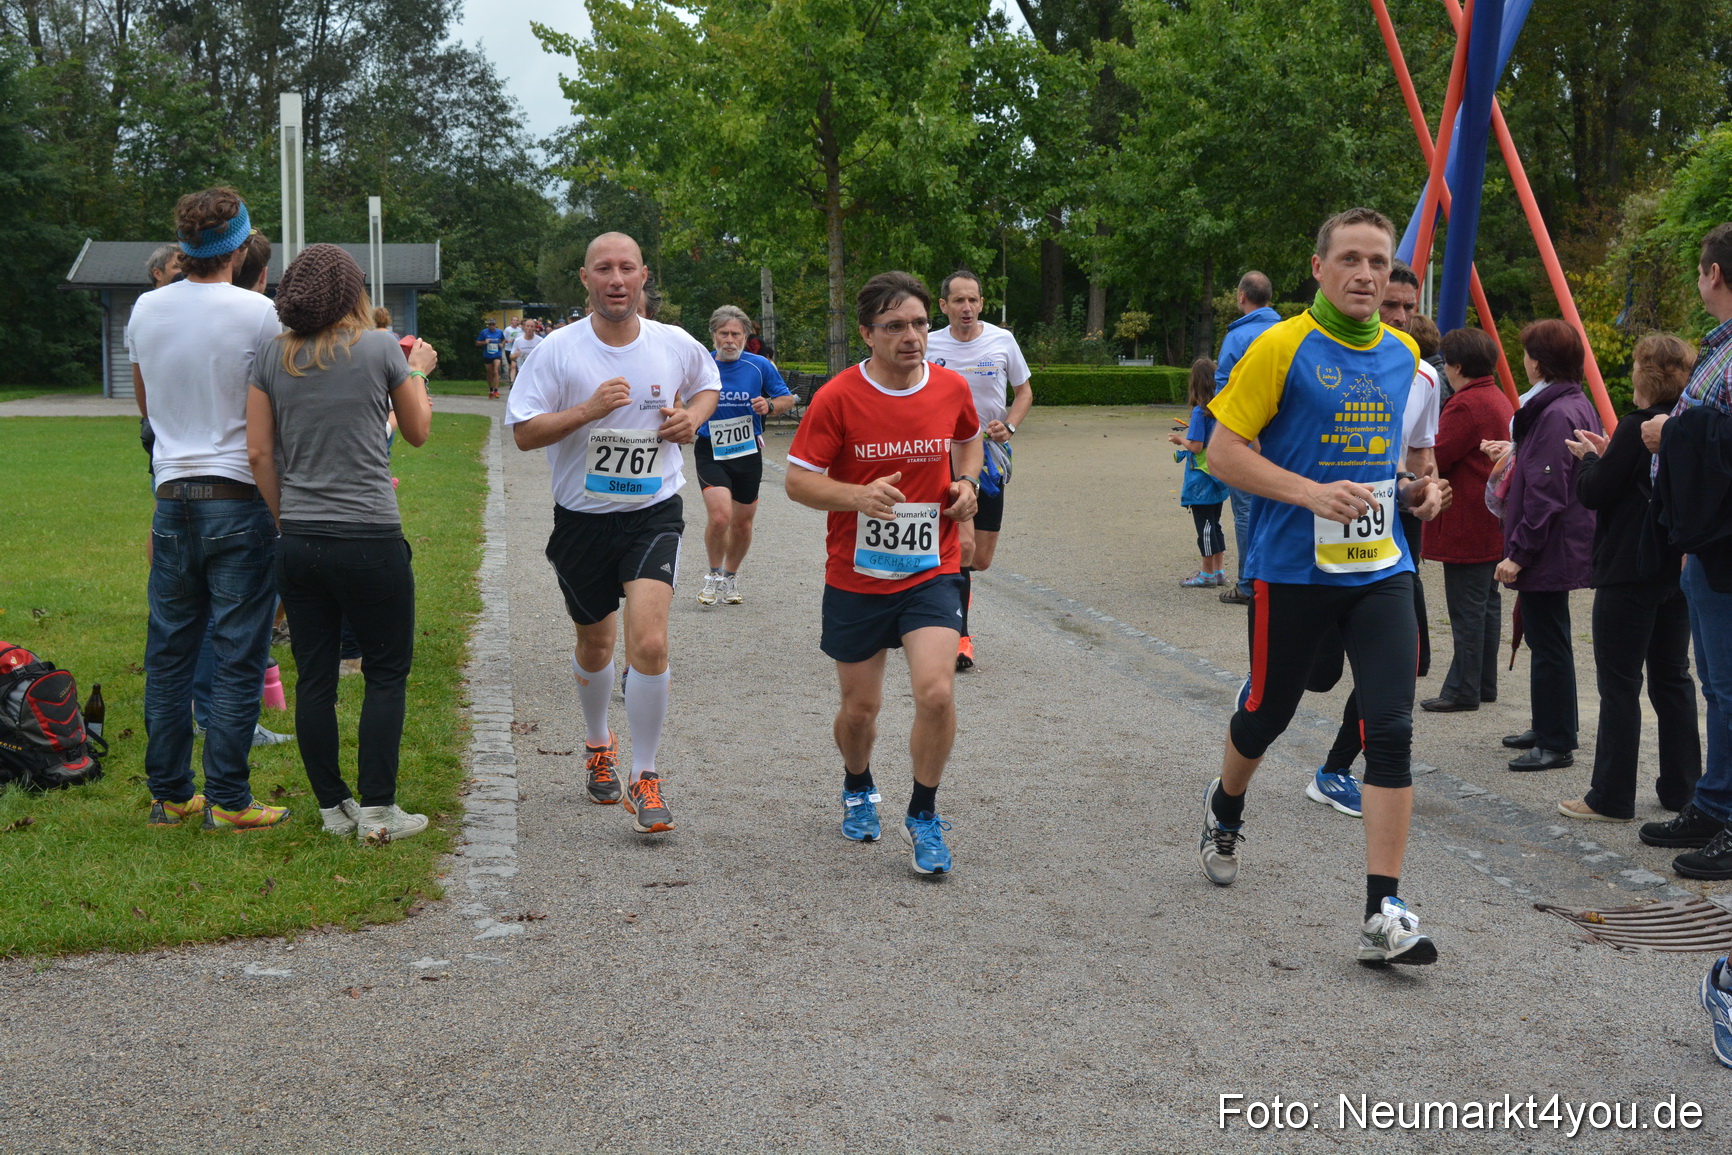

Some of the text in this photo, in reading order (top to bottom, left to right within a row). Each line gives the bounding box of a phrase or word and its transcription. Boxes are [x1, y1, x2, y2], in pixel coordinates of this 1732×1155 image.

[590, 435, 655, 444] PARTL Neumarkt
[715, 425, 750, 445] 2700
[854, 438, 942, 459] NEUMARKT
[594, 445, 659, 475] 2767
[172, 485, 214, 499] PMA
[609, 480, 643, 493] Stefan
[865, 519, 933, 551] 3346
[1347, 547, 1379, 560] Klaus
[869, 554, 920, 568] GERHARD
